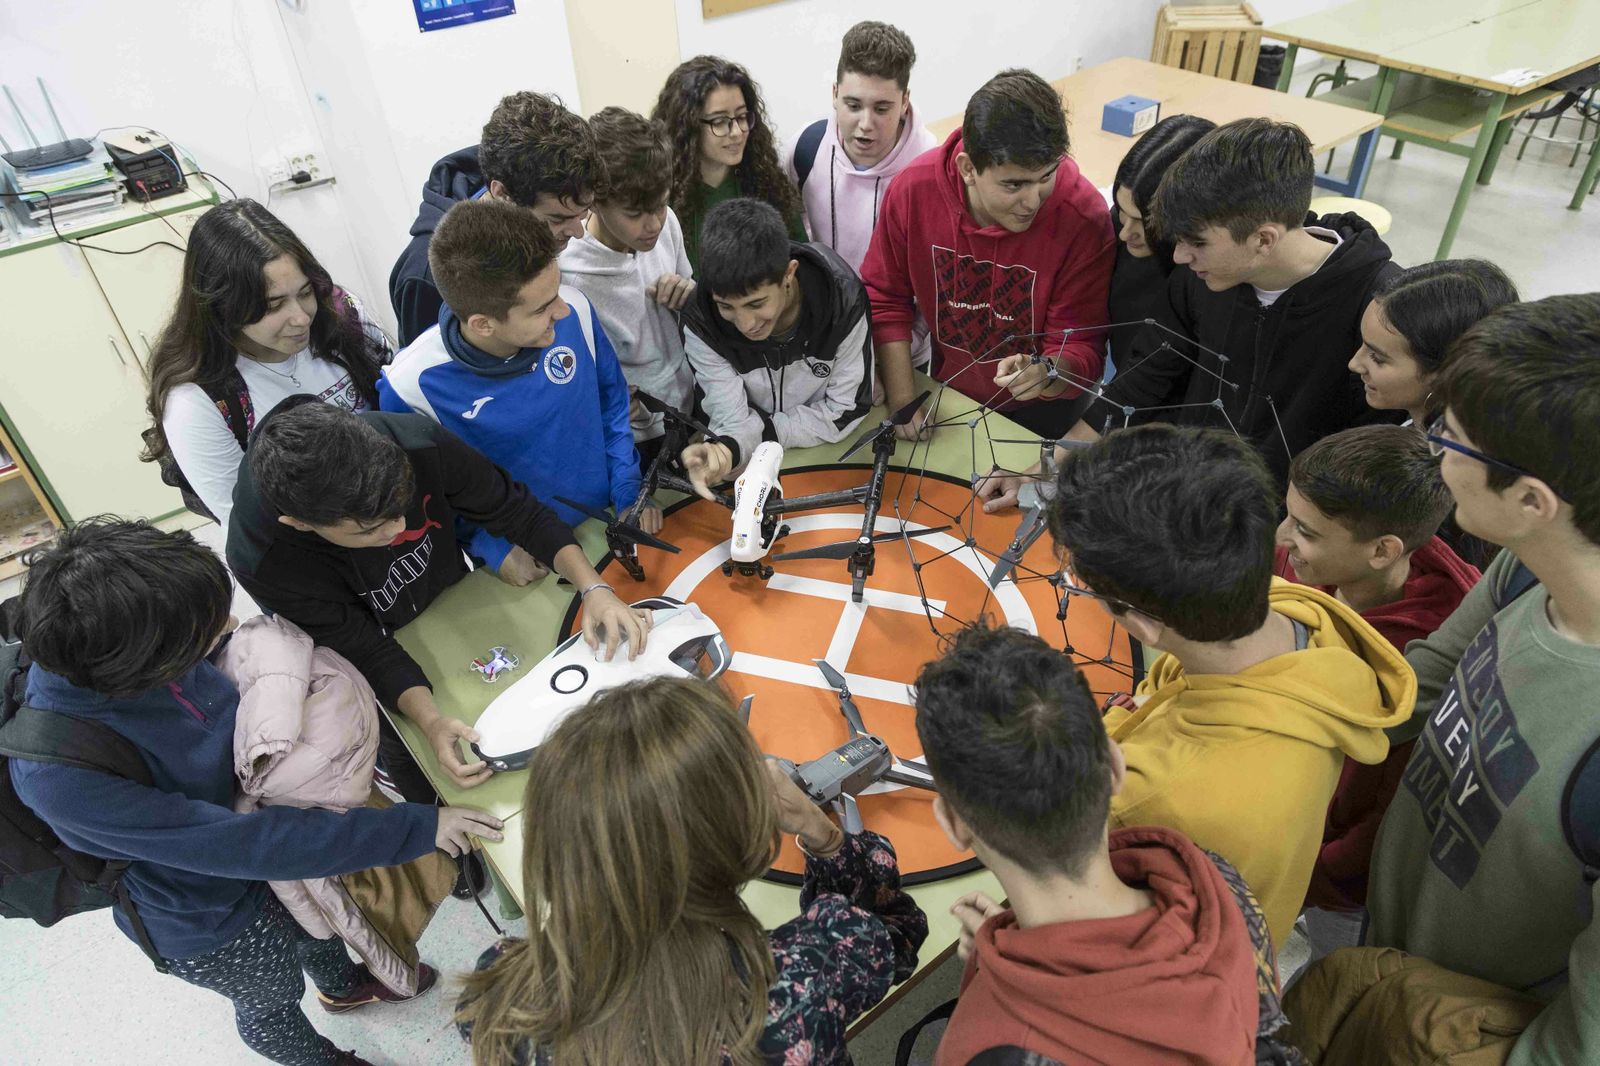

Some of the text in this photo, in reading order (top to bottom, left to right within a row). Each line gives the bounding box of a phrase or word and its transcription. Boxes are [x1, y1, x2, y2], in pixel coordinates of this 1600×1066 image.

[948, 300, 1015, 321] SUPERNARAL
[358, 534, 433, 612] UMA
[1434, 676, 1480, 806] VERY
[1464, 624, 1515, 763] ENJOY
